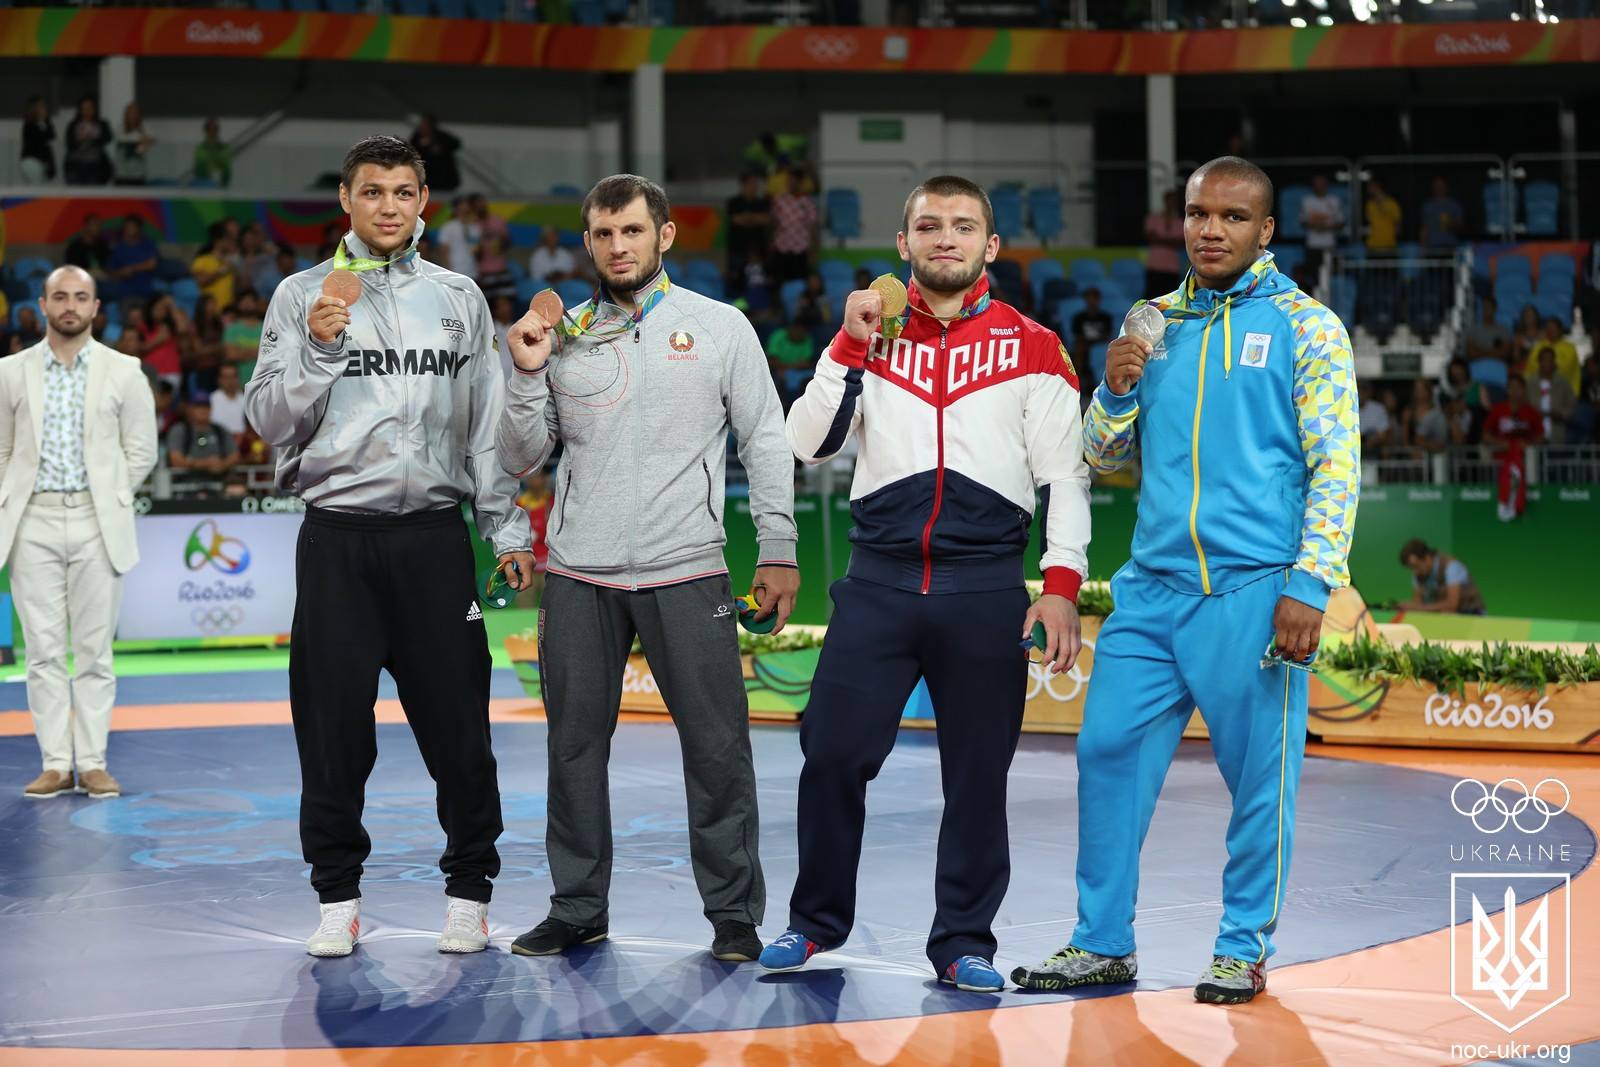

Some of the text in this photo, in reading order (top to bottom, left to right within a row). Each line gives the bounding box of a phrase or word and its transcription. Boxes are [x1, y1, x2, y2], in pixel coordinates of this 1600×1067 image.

[343, 349, 471, 379] ERMANY
[178, 580, 255, 601] Rio2016
[1425, 693, 1554, 729] Rio2016
